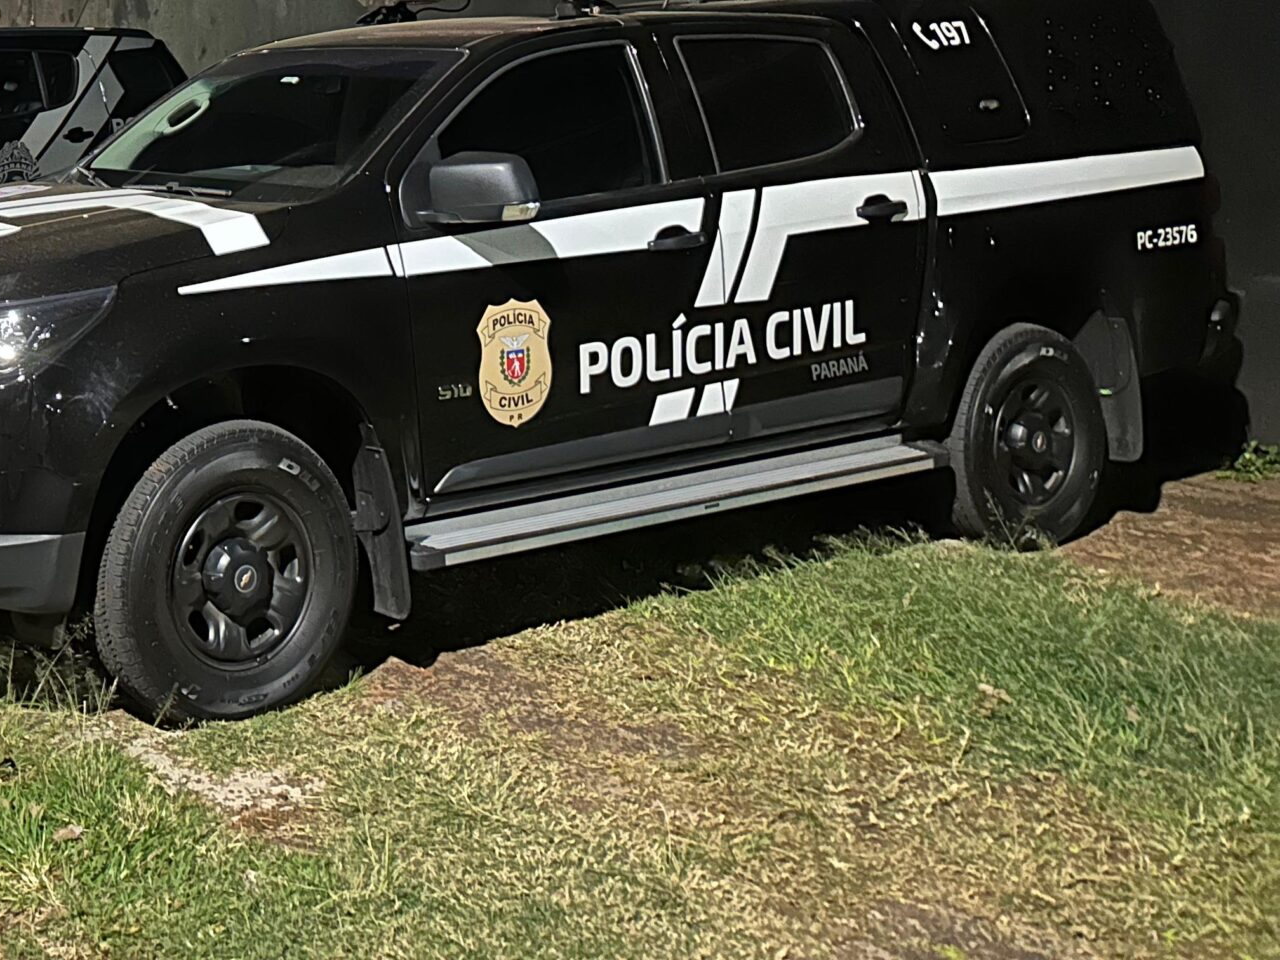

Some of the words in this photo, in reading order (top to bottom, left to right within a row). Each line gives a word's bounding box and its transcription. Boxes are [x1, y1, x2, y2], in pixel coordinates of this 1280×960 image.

[929, 21, 970, 46] 197
[1137, 224, 1198, 251] PC-23576
[492, 309, 535, 331] POLÍCIA
[579, 313, 757, 394] POLÍCIA
[765, 300, 866, 362] CIVIL
[811, 350, 869, 381] PARANÁ
[498, 393, 534, 409] CIVIL
